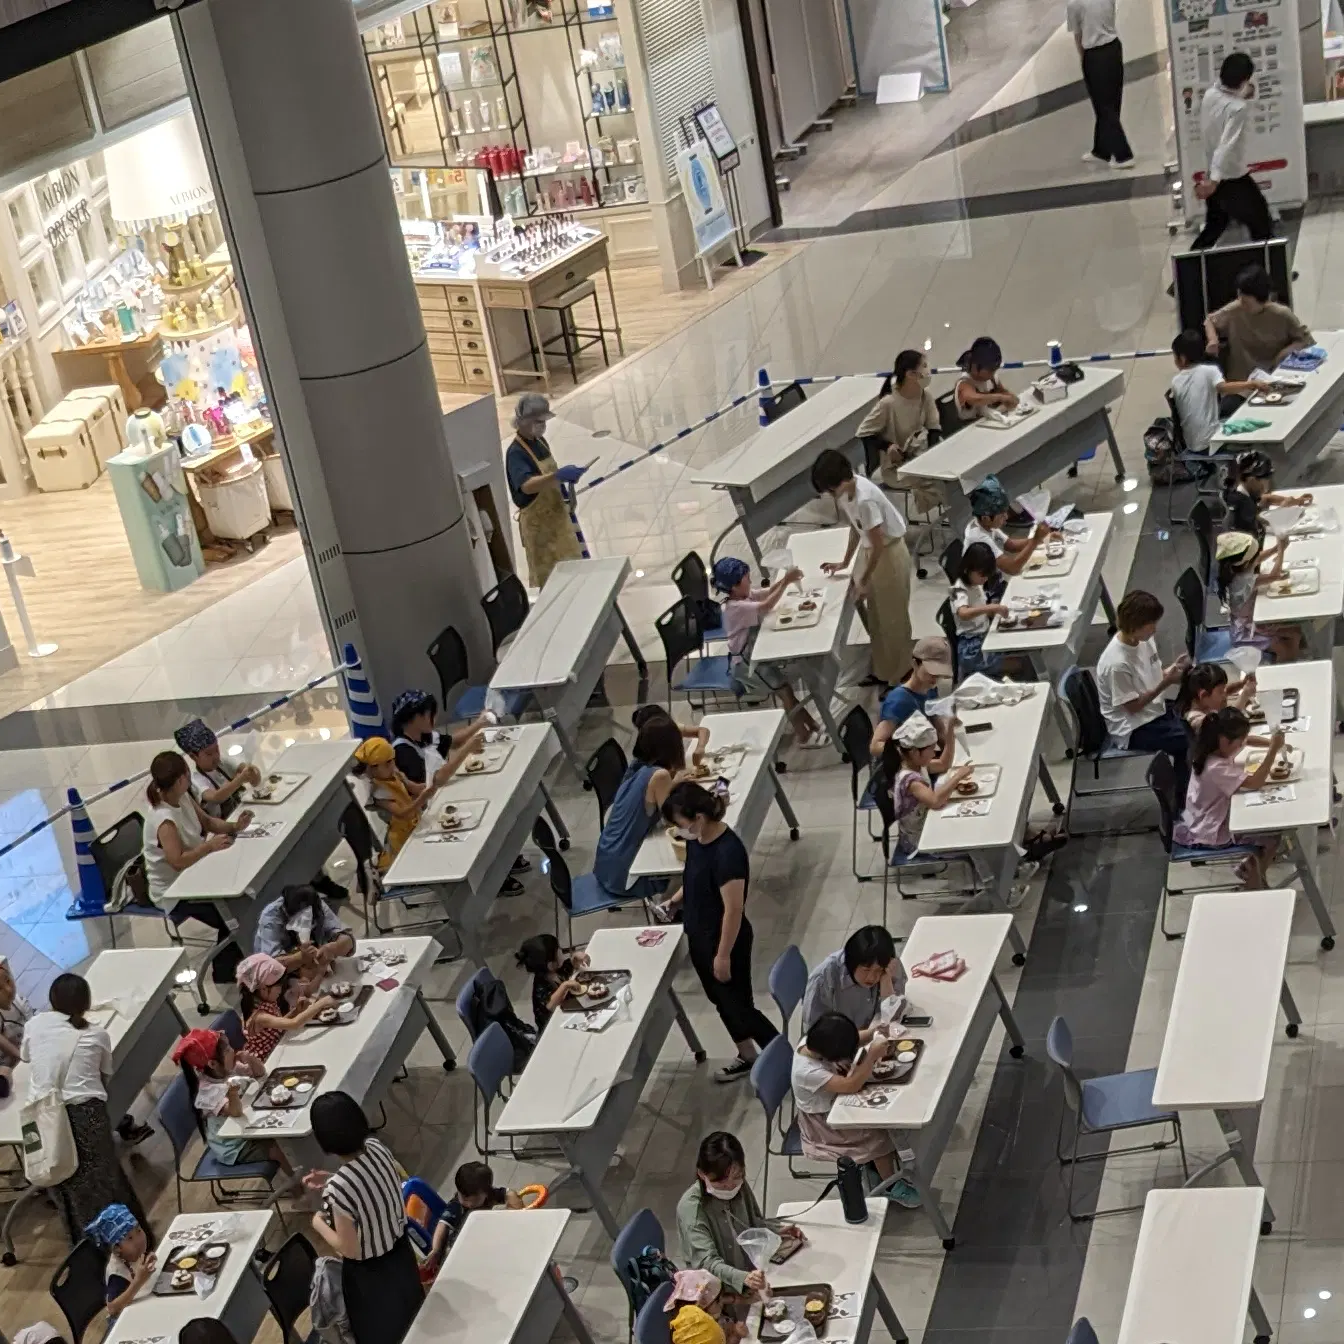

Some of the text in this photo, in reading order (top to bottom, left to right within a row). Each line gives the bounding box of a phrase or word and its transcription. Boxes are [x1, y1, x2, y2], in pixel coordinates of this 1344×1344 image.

[42, 165, 80, 212] ALBION
[170, 184, 208, 206] ALBION
[47, 198, 91, 248] DRESSER
